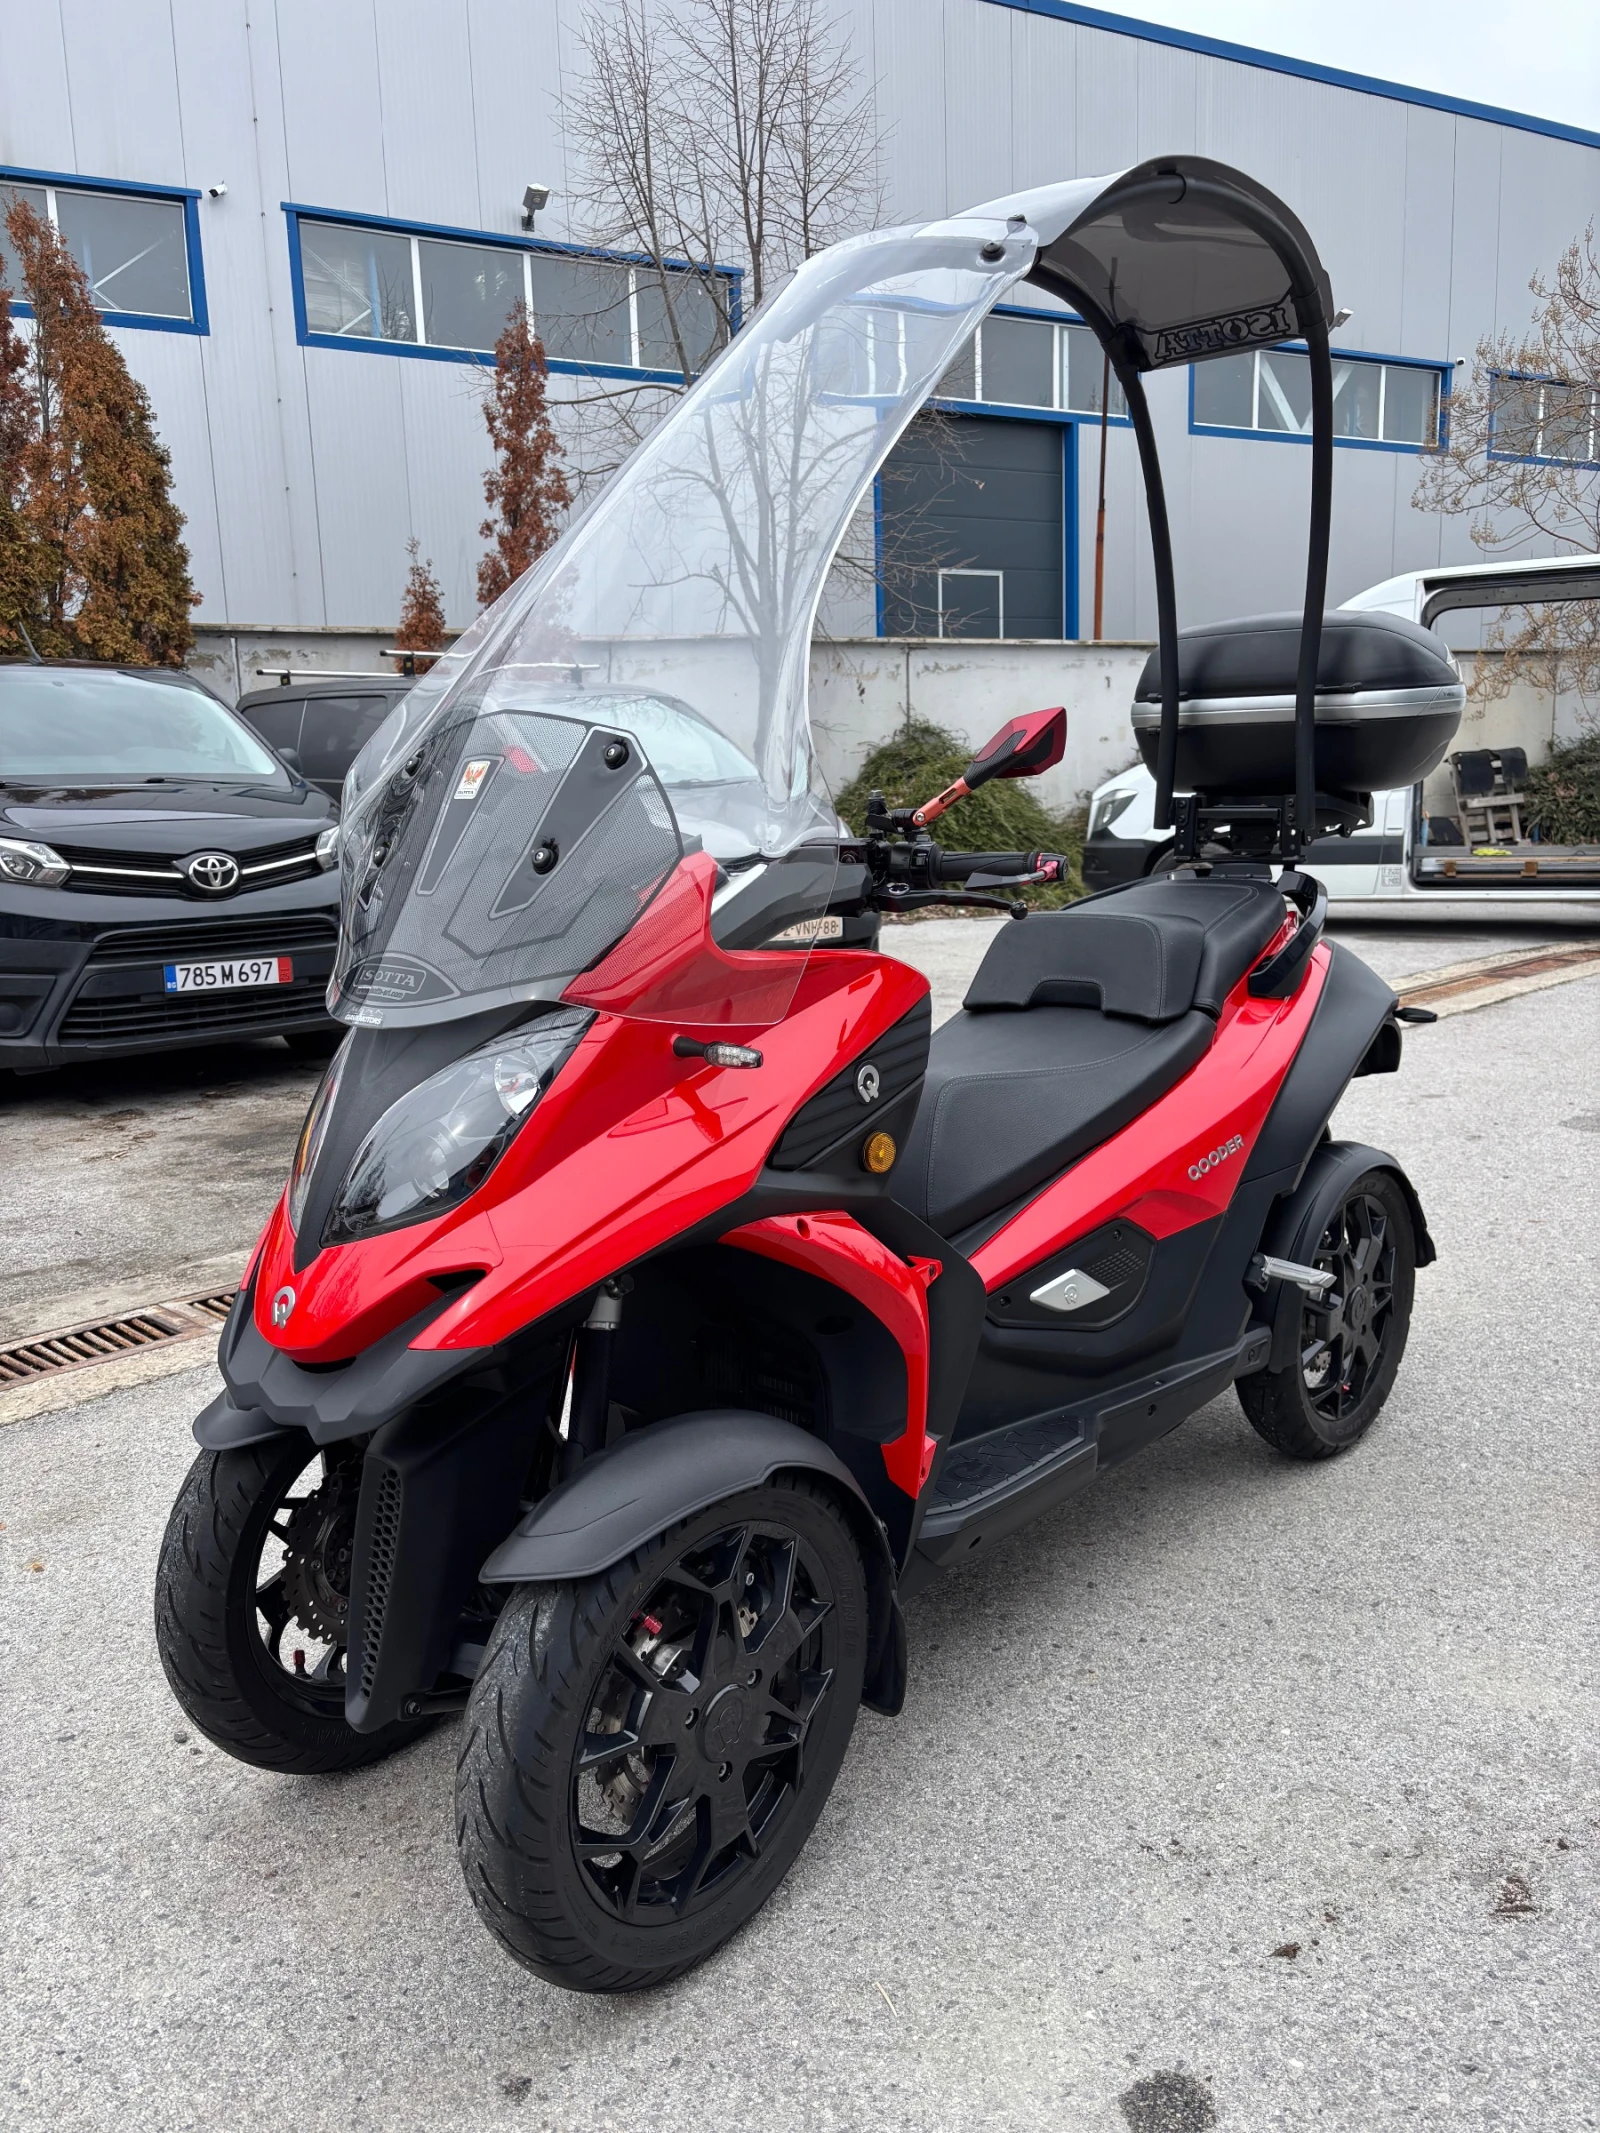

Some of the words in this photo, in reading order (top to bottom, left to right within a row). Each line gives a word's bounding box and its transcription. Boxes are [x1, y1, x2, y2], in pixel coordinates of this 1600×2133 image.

[179, 965, 217, 989] 785
[220, 963, 234, 985] M
[238, 961, 273, 983] 697
[359, 968, 416, 988] ISOTTA
[1187, 1133, 1245, 1181] QOODER
